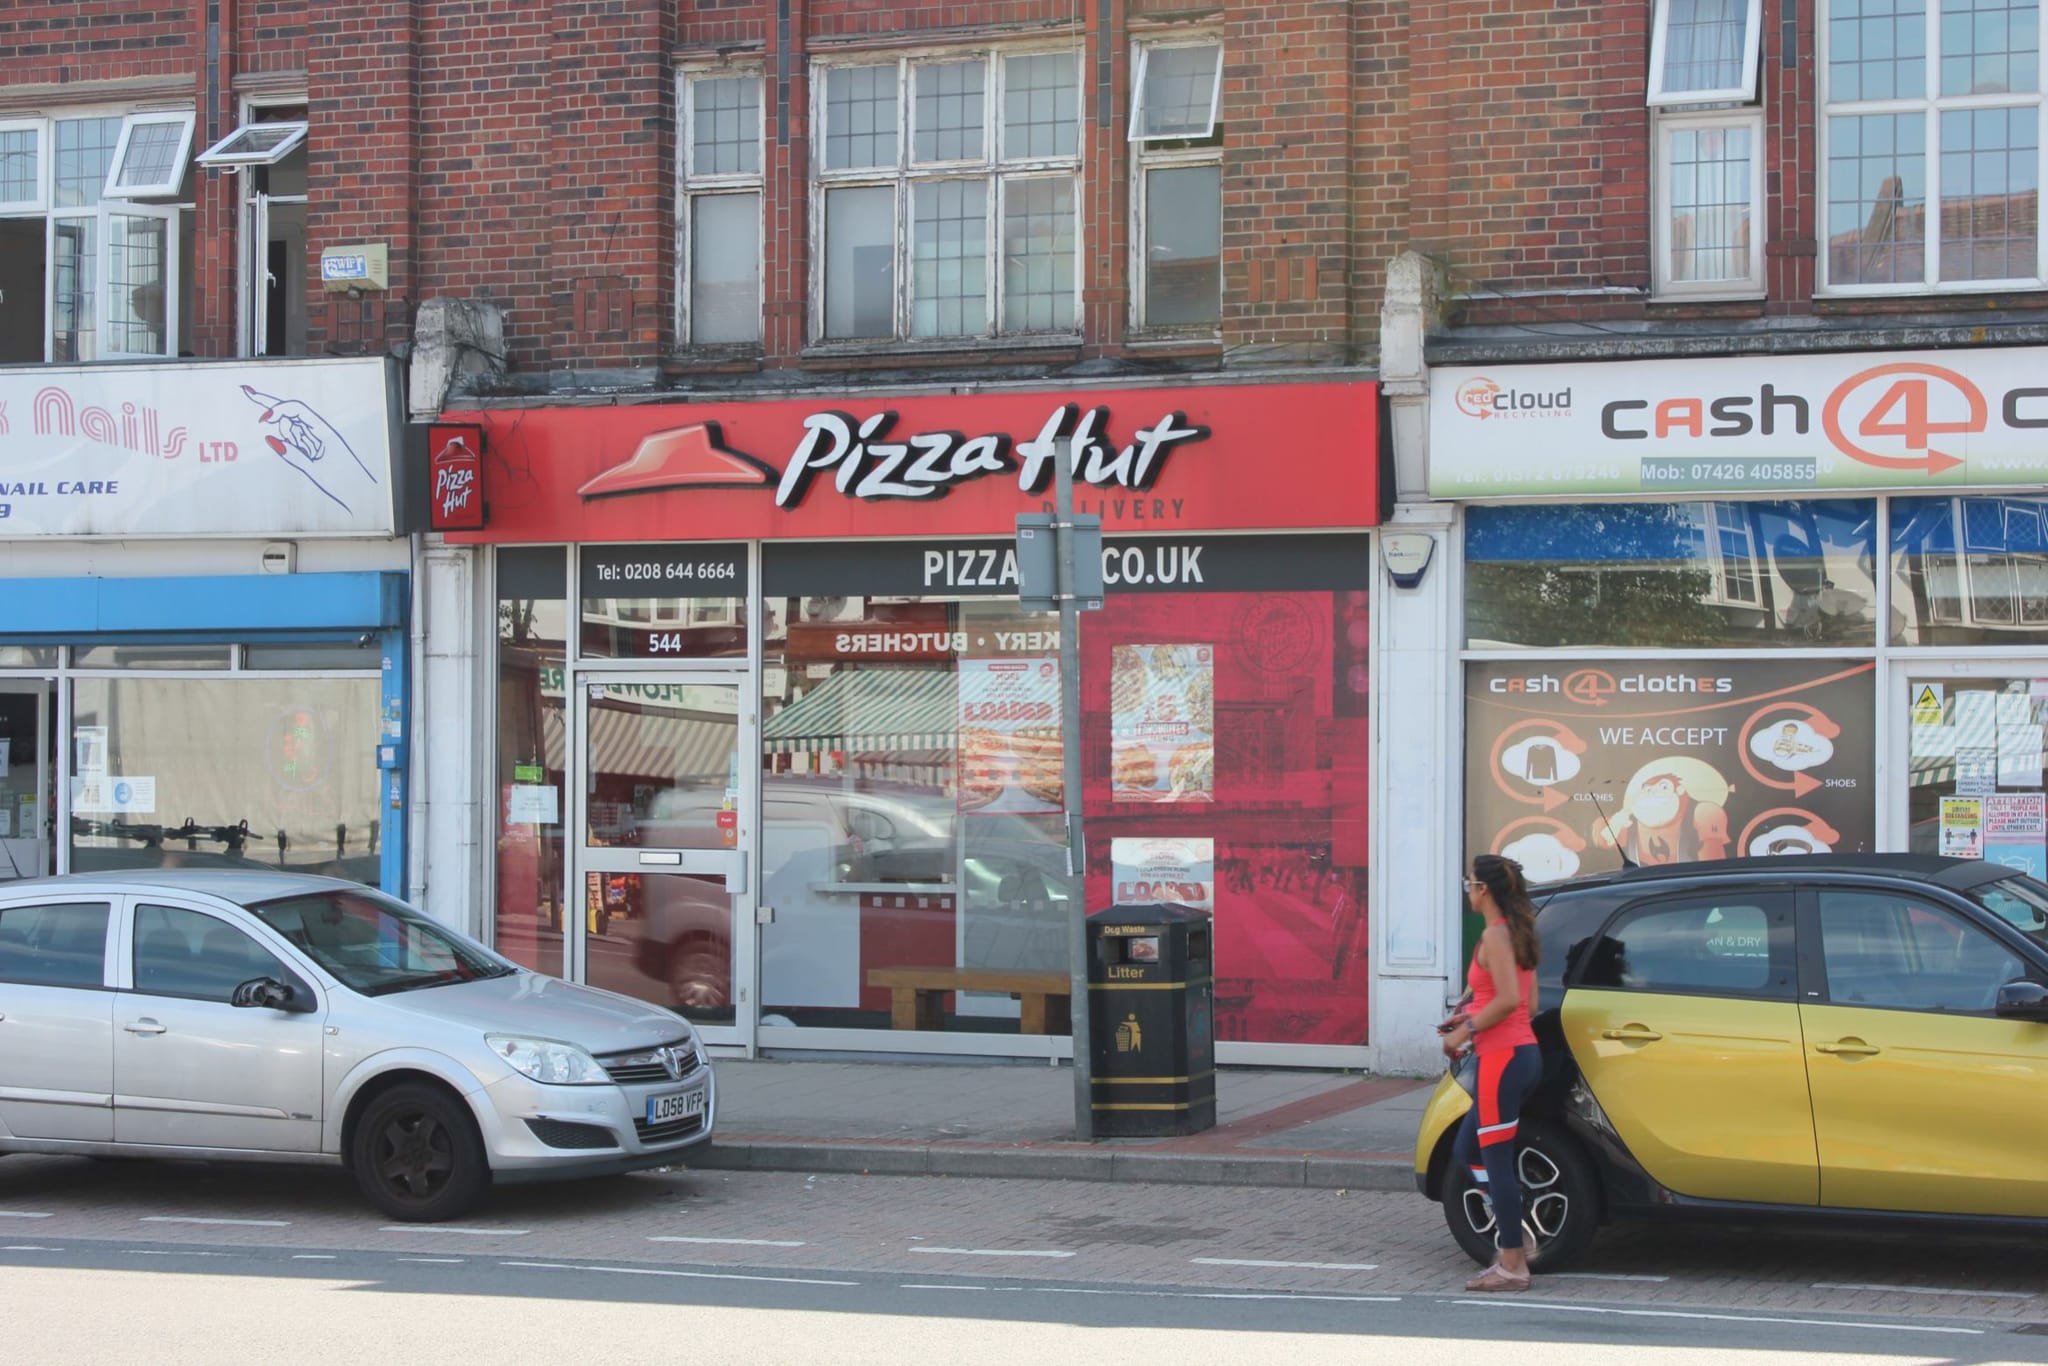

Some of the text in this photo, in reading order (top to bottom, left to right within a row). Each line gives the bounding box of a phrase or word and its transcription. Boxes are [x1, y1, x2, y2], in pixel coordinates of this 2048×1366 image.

[1494, 409, 1572, 419] RECYCLING
[34, 386, 187, 459] Nails
[200, 441, 239, 462] LTD
[776, 402, 1199, 507] Pizza Hut
[1641, 464, 1686, 480] Mob:
[1691, 463, 1745, 480] 07426
[1750, 463, 1816, 480] 405855
[57, 481, 119, 494] CARE
[436, 464, 474, 500] Pizza
[443, 486, 473, 518] Hut
[597, 563, 735, 580] Tel: 0208 644 6664
[649, 634, 682, 653] 544
[1600, 727, 1728, 746] WE ACCEPT
[1825, 778, 1857, 789] SHOES
[1104, 925, 1146, 936] Dog Waste
[1738, 936, 1761, 947] DRY
[1108, 966, 1145, 979] Litter
[686, 1091, 703, 1112] VFP
